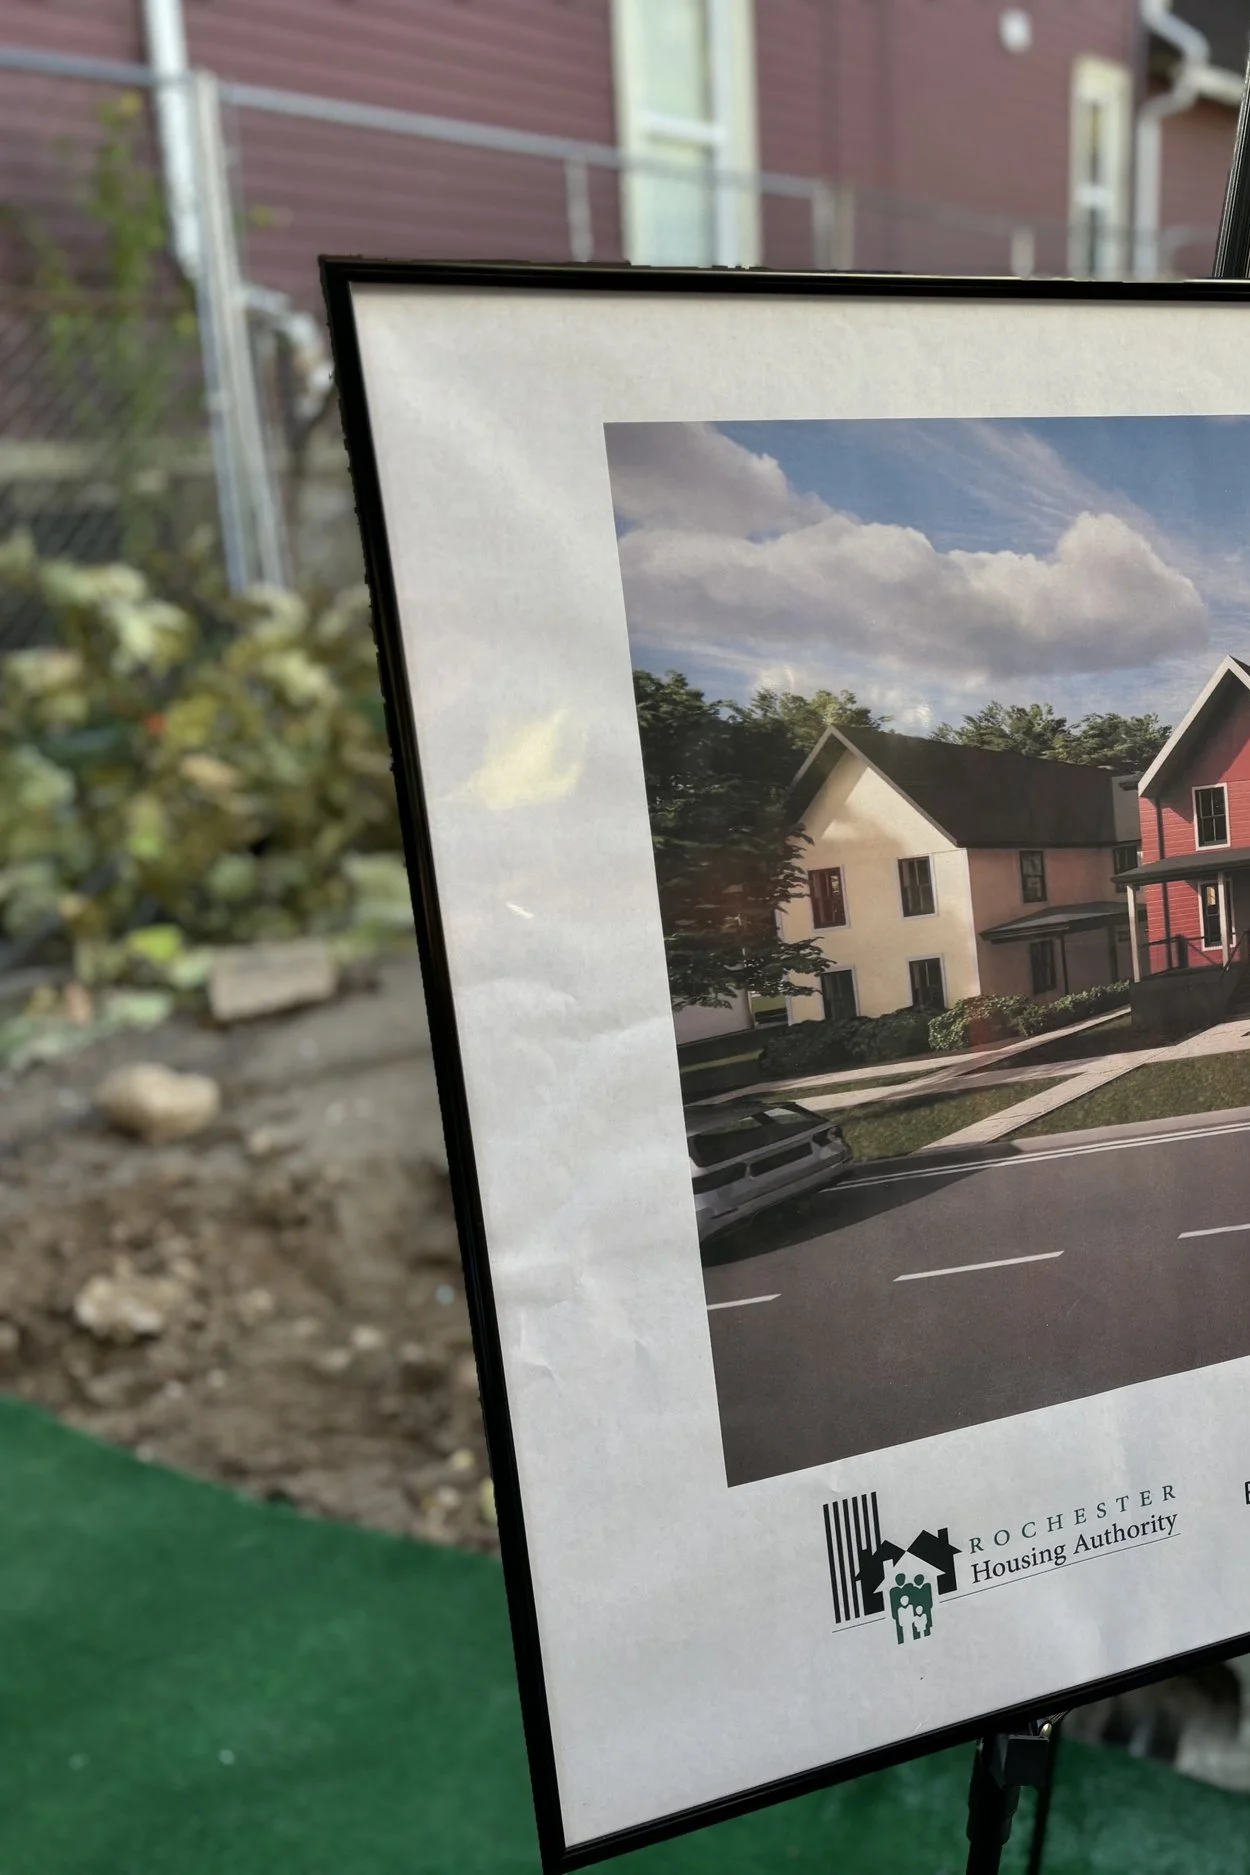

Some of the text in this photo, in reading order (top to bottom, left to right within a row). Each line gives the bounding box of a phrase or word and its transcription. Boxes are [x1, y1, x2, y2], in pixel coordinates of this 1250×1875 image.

[969, 1484, 1177, 1554] ROCHESTER
[970, 1512, 1179, 1585] Housing Authority
